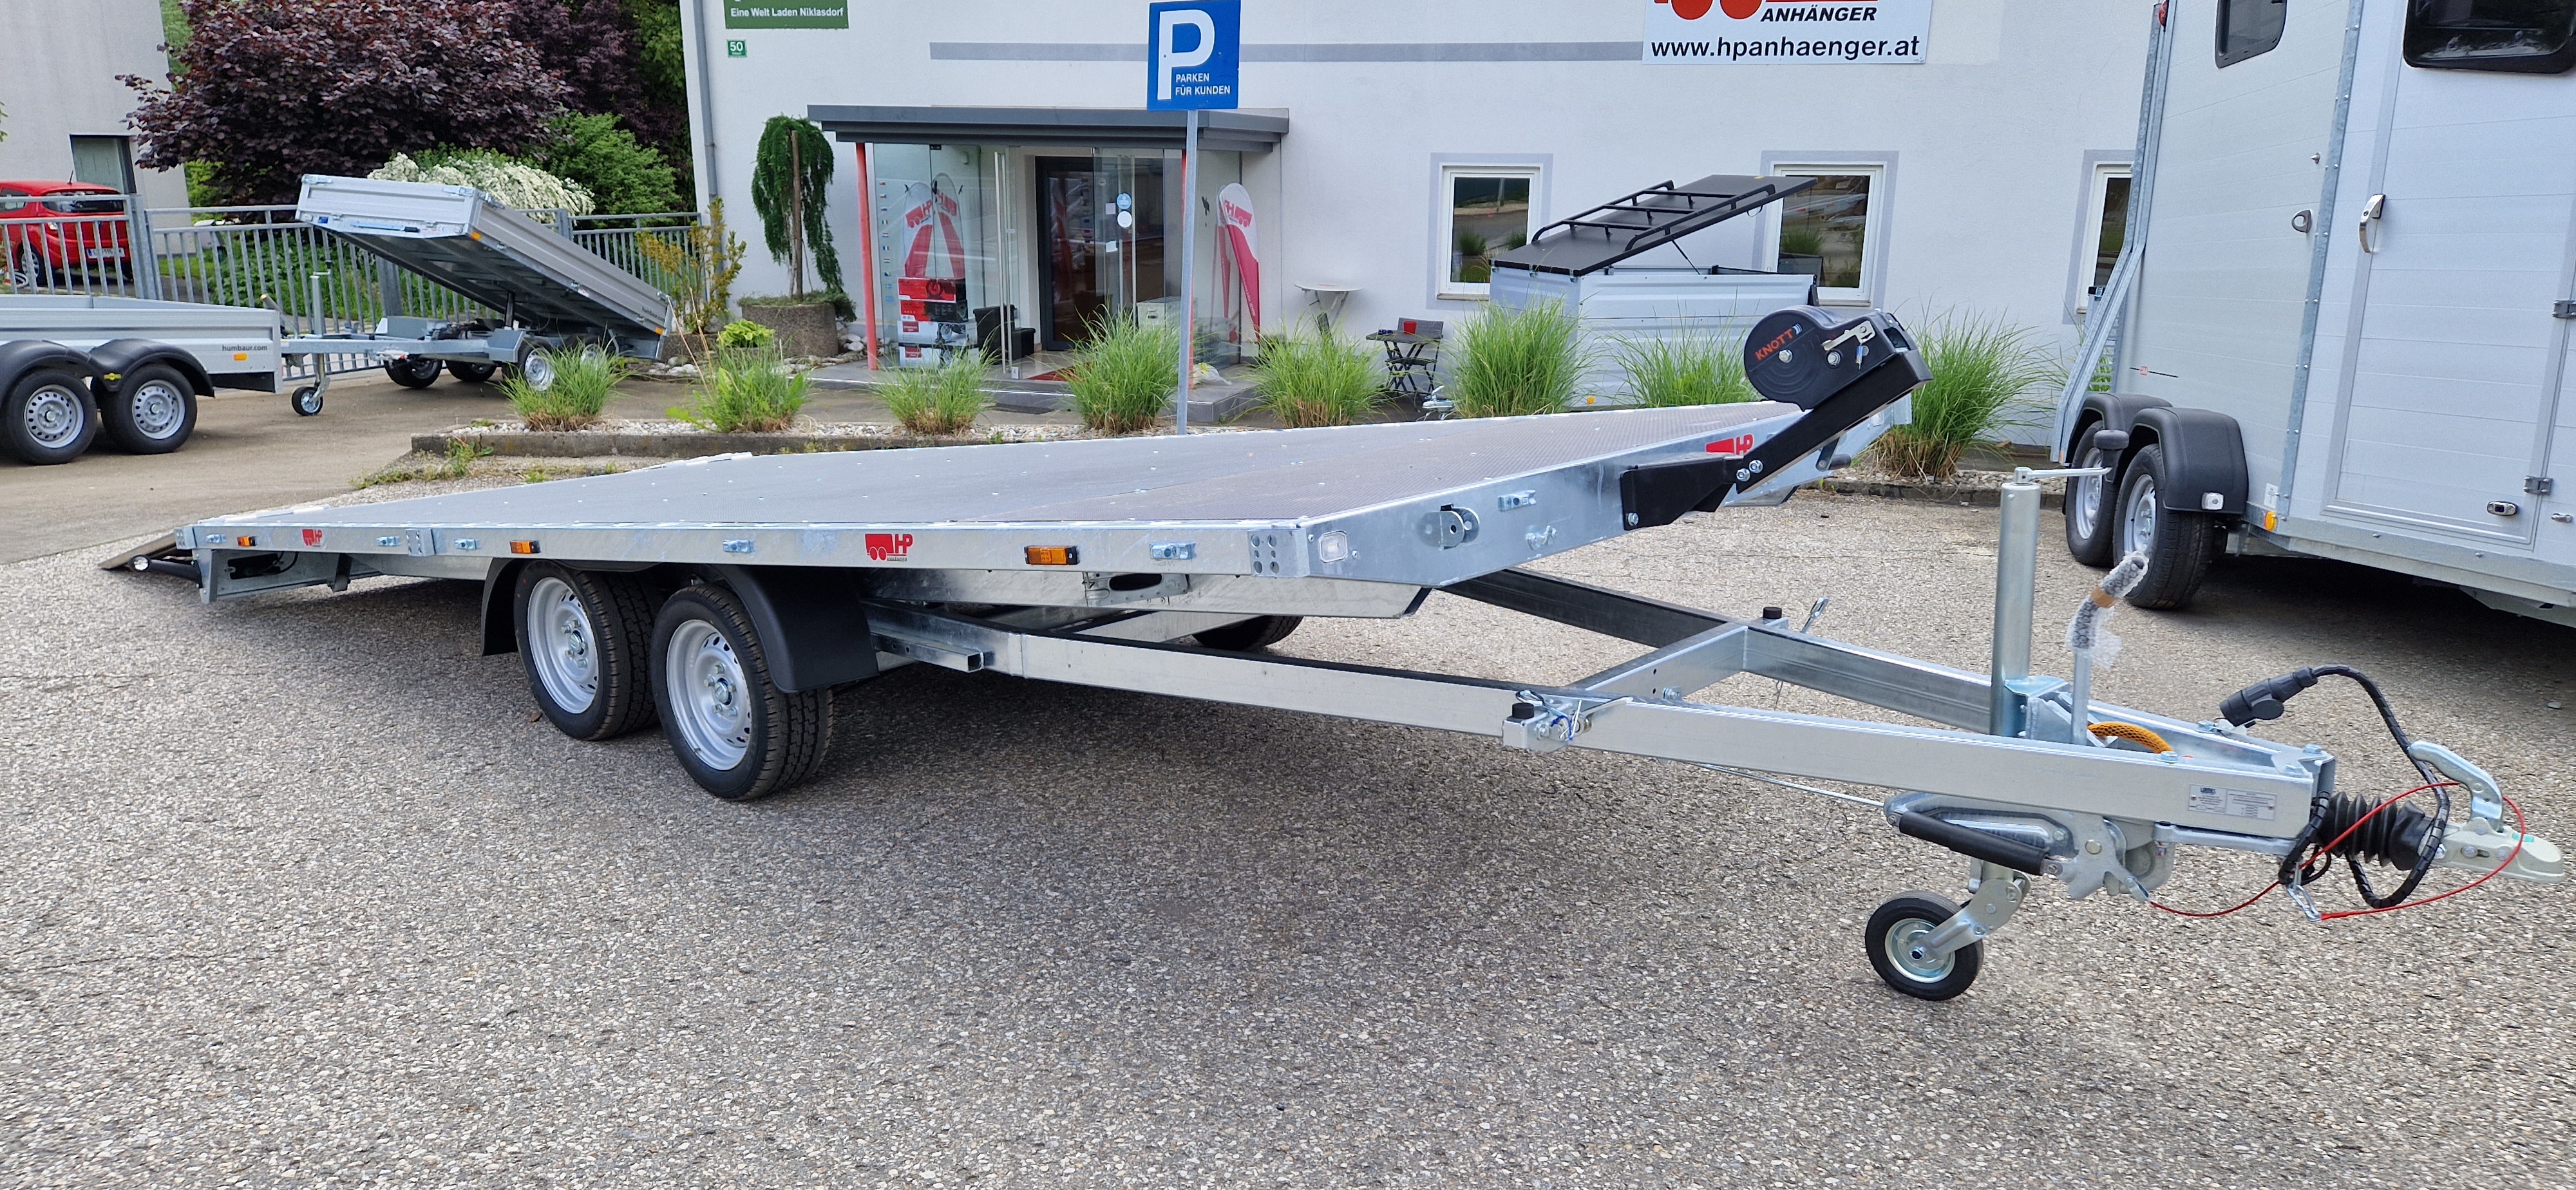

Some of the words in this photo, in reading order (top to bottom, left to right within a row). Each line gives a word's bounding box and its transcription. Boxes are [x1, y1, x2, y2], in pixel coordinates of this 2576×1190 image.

[730, 8, 749, 17] Eine
[750, 8, 770, 17] Welt
[772, 7, 798, 16] Laden
[799, 7, 844, 16] Niklasdorf
[1761, 5, 1877, 22] ANHÄNGER
[730, 41, 743, 52] 50
[1157, 9, 1215, 100] P
[1651, 35, 1920, 61] www.hpanhaenger.at
[1175, 73, 1209, 83] PARKEN
[1175, 84, 1192, 95] FÜR
[1195, 85, 1231, 95] KUNDEN
[1755, 328, 1794, 361] KNOTT
[1736, 434, 1754, 455] HP
[895, 533, 913, 554] HP
